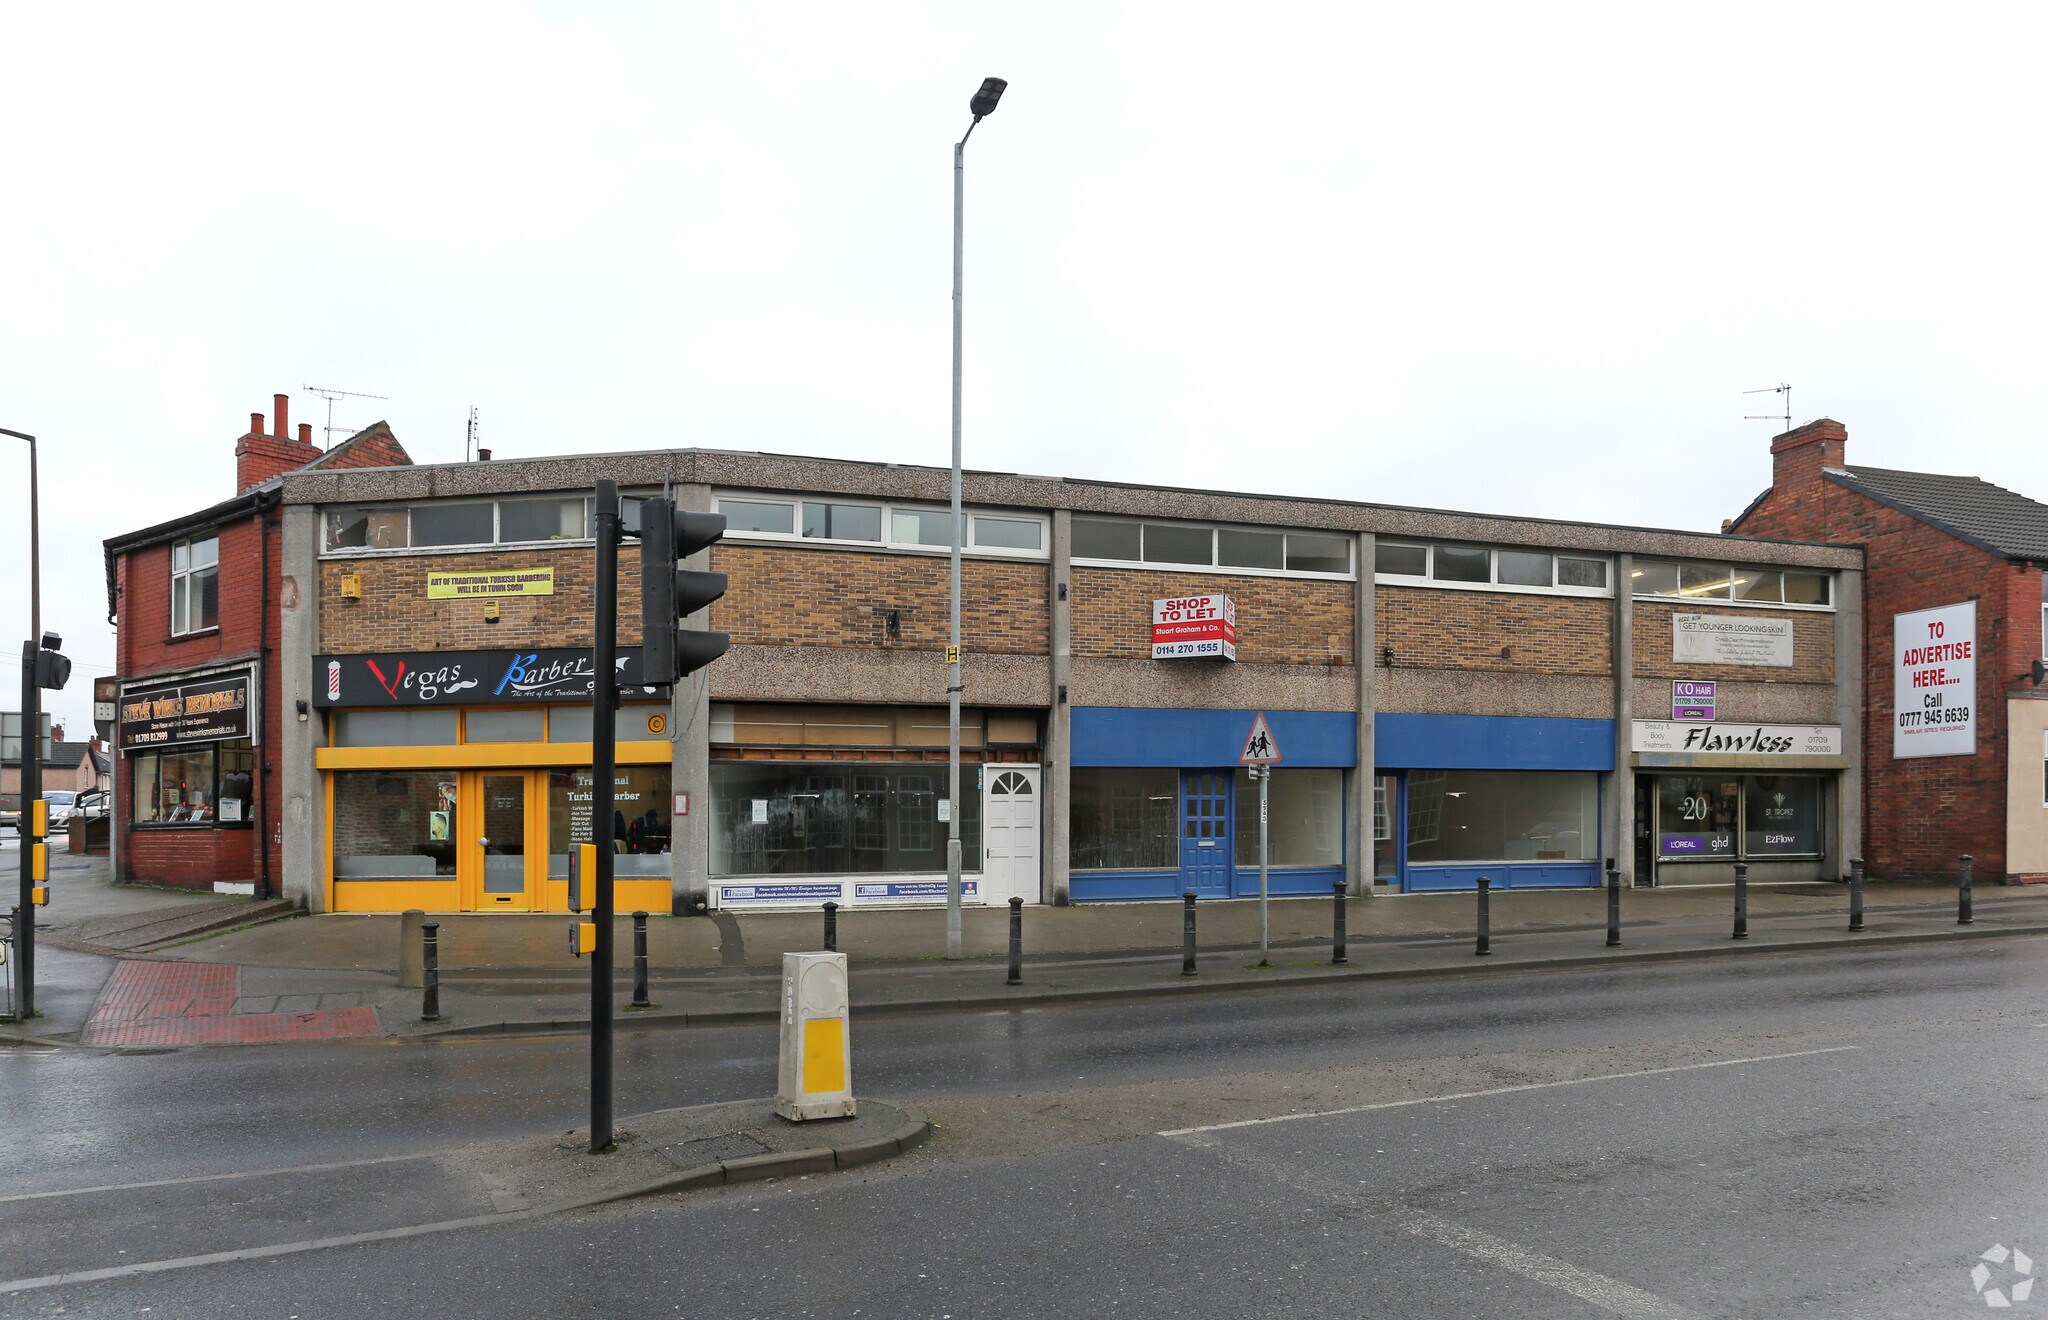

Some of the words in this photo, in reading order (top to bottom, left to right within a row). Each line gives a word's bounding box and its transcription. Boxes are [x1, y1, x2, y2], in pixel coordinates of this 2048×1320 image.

[452, 576, 489, 584] TRADITIONAL
[490, 575, 516, 584] TURKISH
[517, 574, 550, 582] BARBERING
[457, 586, 472, 594] WILL
[488, 584, 506, 592] TOWN
[507, 584, 524, 592] SOON
[1166, 598, 1210, 610] SHOP
[1160, 611, 1181, 621] TO
[1187, 608, 1216, 620] LET
[1698, 623, 1734, 632] YOUNGER
[1734, 624, 1767, 633] LOOKING
[1928, 622, 1944, 639] TO
[948, 647, 957, 661] H
[1156, 646, 1174, 654] 0114
[1178, 645, 1194, 654] 270
[1197, 643, 1218, 652] 1555
[1903, 641, 1972, 666] ADVERTISE
[366, 659, 461, 700] Vegas
[1913, 668, 1960, 688] HERE....
[535, 690, 542, 698] of
[554, 688, 588, 696] Traditional
[1696, 686, 1712, 694] HAIR
[122, 698, 151, 723] STEVE
[153, 696, 184, 719] WINKS
[184, 688, 245, 715] MEMORIALS
[1924, 692, 1942, 708] Call
[1900, 711, 1922, 727] 0777
[1924, 710, 1942, 724] 945
[1945, 706, 1969, 722] 6639
[1644, 722, 1664, 731] Beauty
[135, 733, 150, 743] 01709
[150, 732, 168, 742] 812999
[1650, 732, 1664, 740] Body
[1684, 726, 1794, 752] Flawless
[1643, 740, 1672, 748] Treatments
[577, 776, 629, 786] Tranal
[1684, 796, 1706, 820] 20
[1712, 836, 1728, 851] ghd
[1766, 834, 1794, 844] EzFlow
